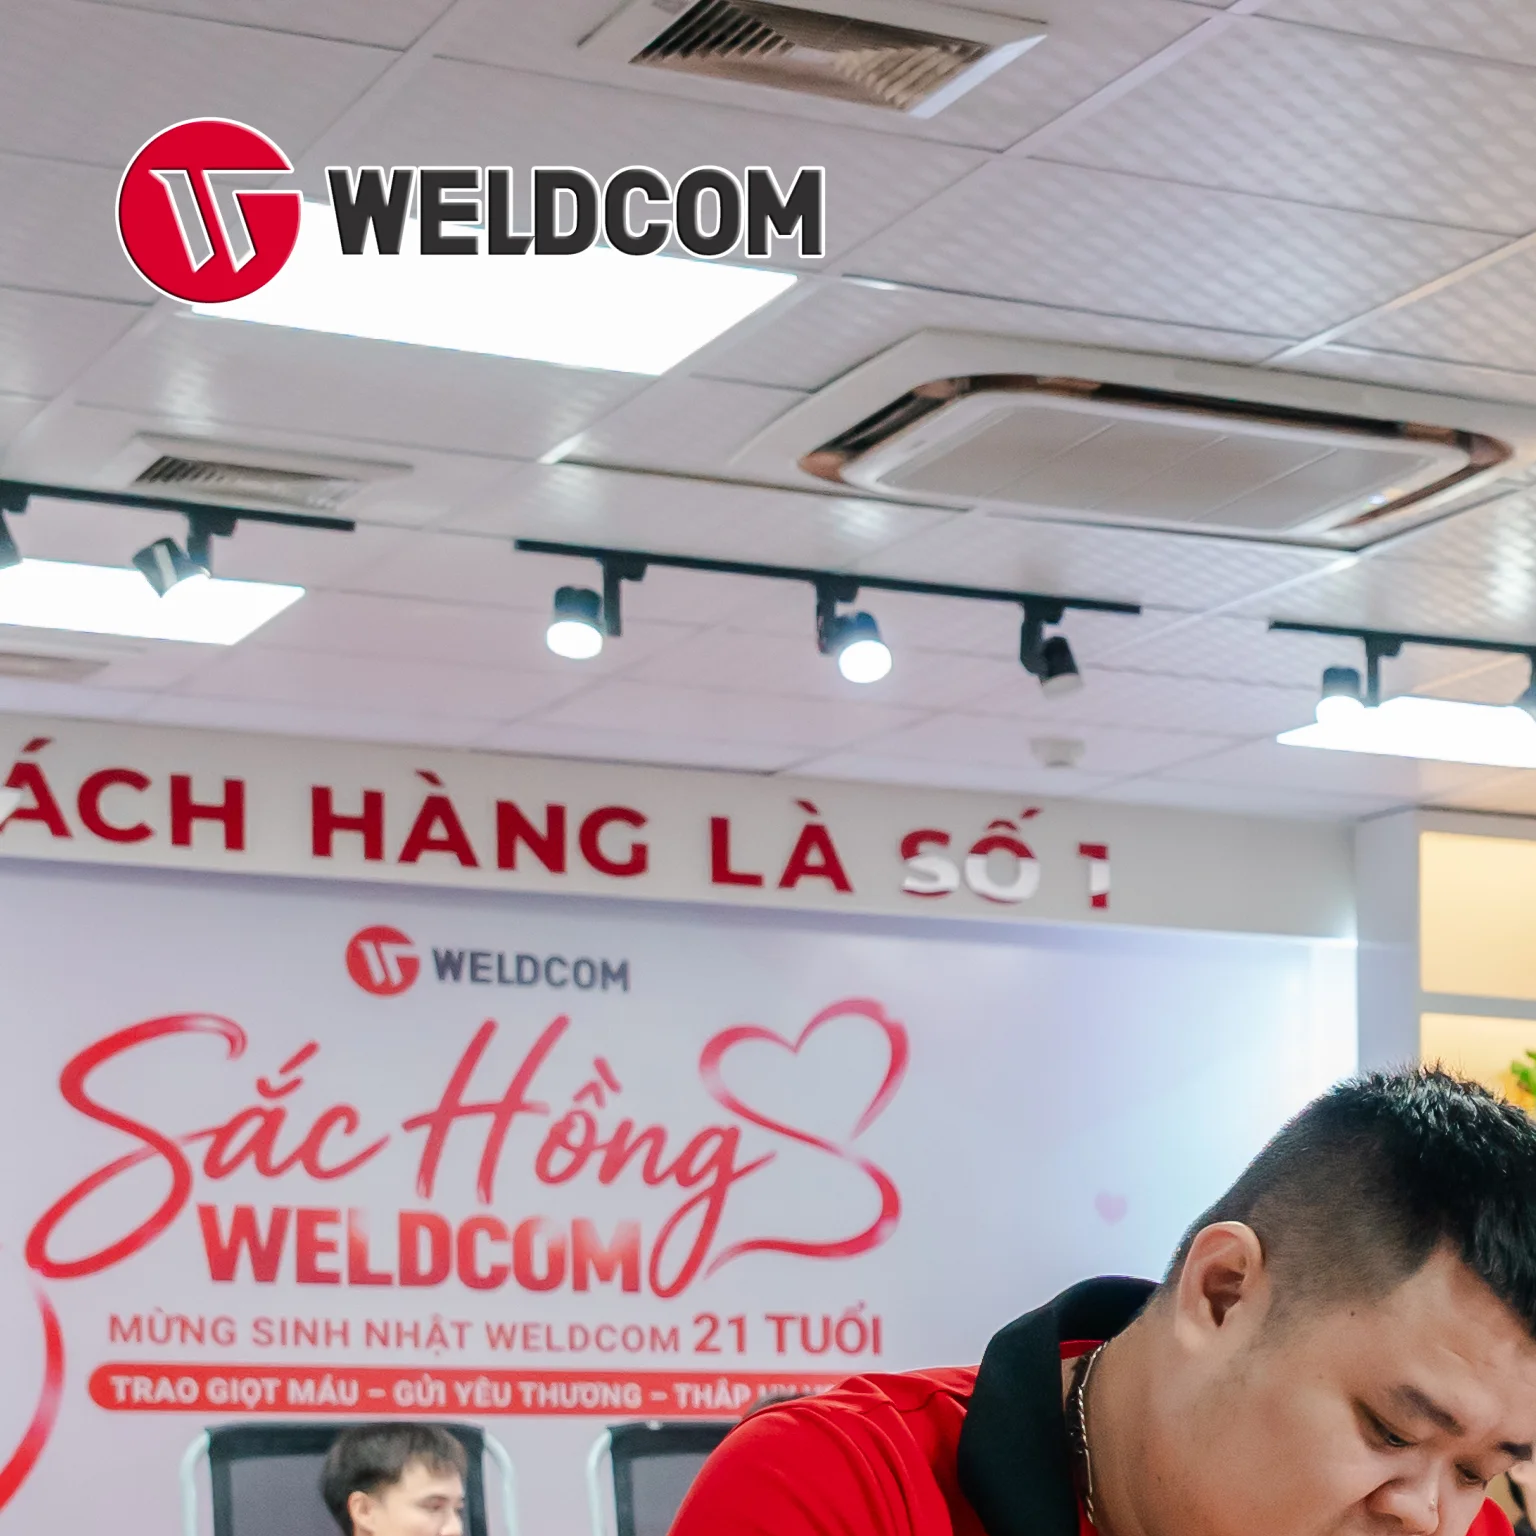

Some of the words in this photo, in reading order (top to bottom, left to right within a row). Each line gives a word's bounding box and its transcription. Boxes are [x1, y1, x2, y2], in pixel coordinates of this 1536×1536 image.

[311, 769, 649, 878] HÀNG
[709, 799, 854, 893] LÀ
[899, 807, 1043, 904] SỐ
[1077, 841, 1112, 910] 1
[431, 947, 630, 993] WELDCOM
[25, 1013, 391, 1279] Sắc
[402, 1014, 778, 1299] Hồng
[196, 1204, 642, 1293] WELDCOM
[108, 1307, 237, 1347] MỪNG
[252, 1316, 350, 1349] SINH
[364, 1313, 473, 1356] NHẬT
[485, 1320, 681, 1353] WELDCOM
[693, 1312, 747, 1354] 21
[764, 1300, 882, 1355] TUỔI
[108, 1374, 200, 1406] TRAO
[205, 1376, 282, 1410] GIỌT
[287, 1373, 360, 1408] MÁU
[452, 1374, 513, 1408] YÊU
